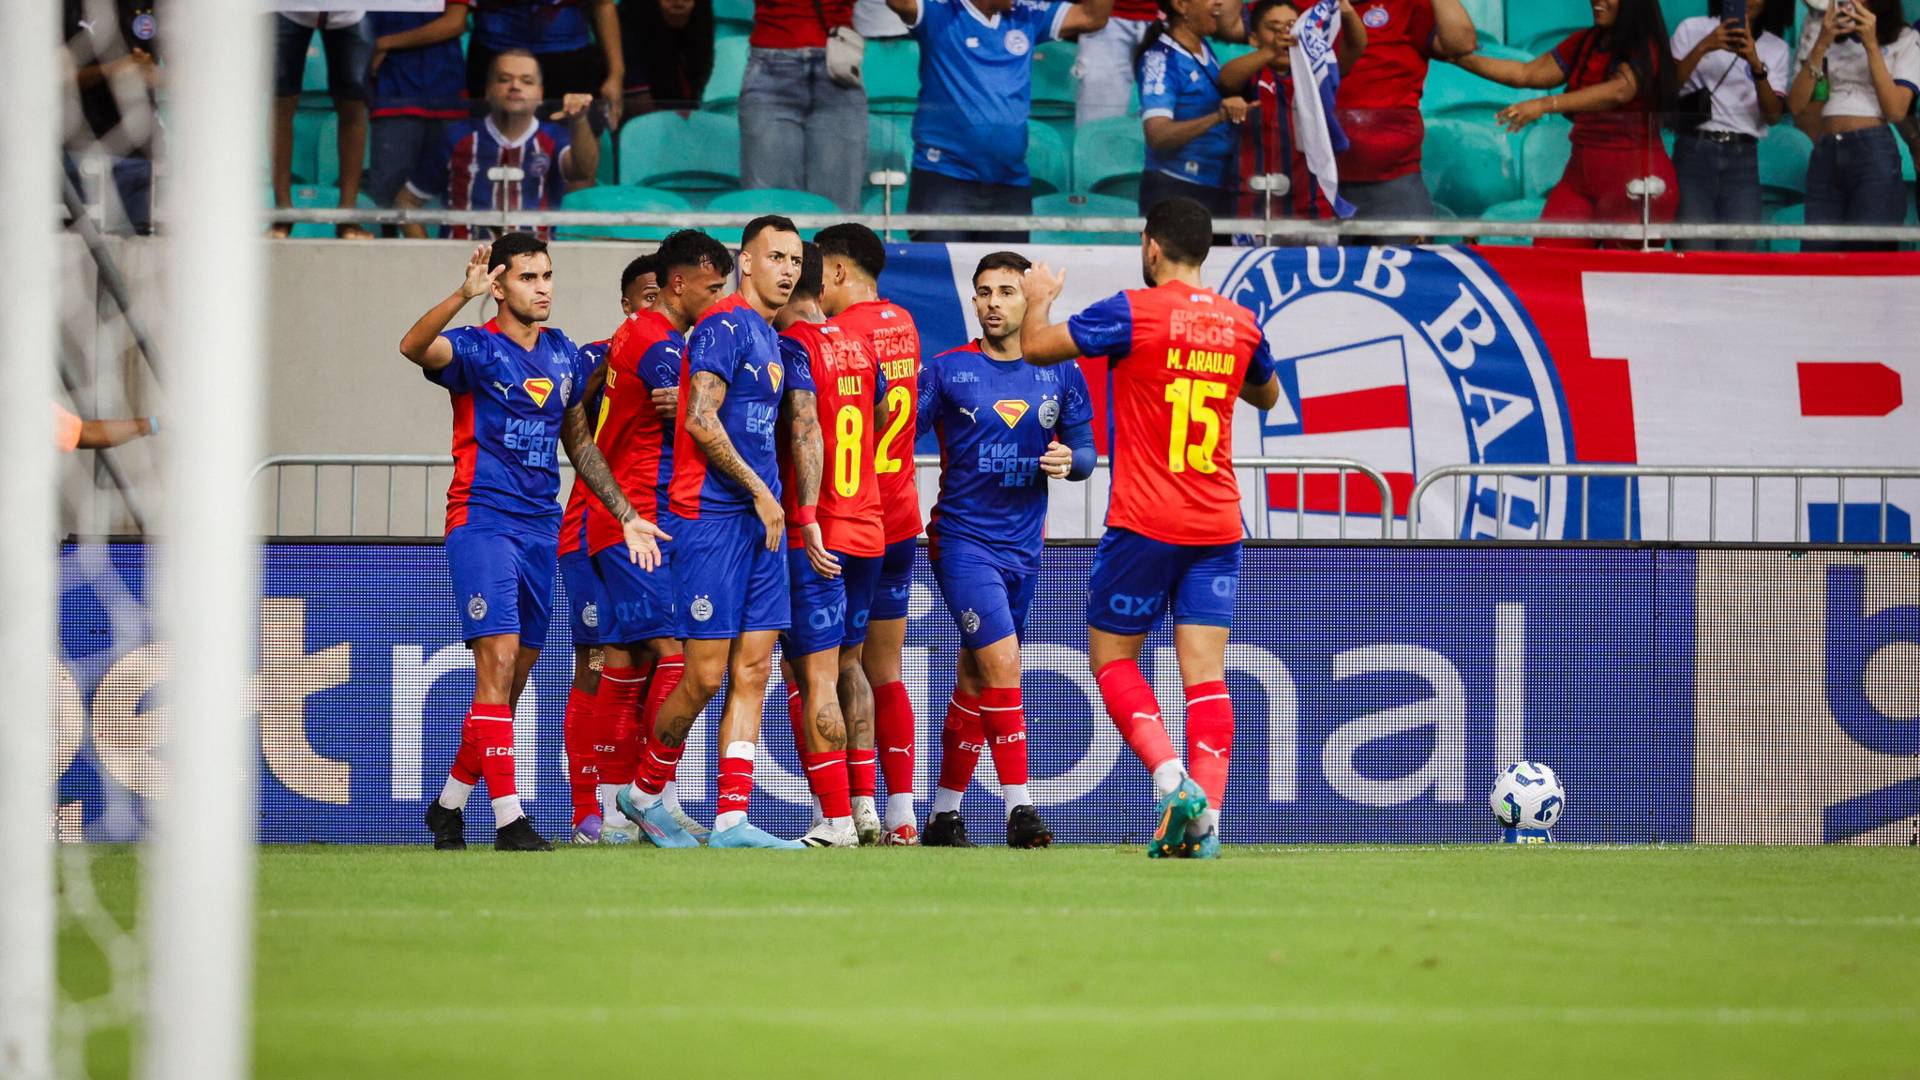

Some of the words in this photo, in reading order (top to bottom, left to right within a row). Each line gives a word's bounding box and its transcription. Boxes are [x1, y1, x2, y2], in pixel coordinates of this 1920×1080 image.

[874, 336, 915, 357] PISOS
[1170, 321, 1235, 348] PISOS
[1167, 347, 1183, 369] M.
[1186, 350, 1235, 375] ARAUJO
[505, 417, 545, 437] VIVA
[875, 386, 911, 473] 2
[1165, 378, 1228, 474] 15
[835, 405, 863, 498] 8
[979, 443, 1018, 458] VIVA
[996, 731, 1026, 745] ECB
